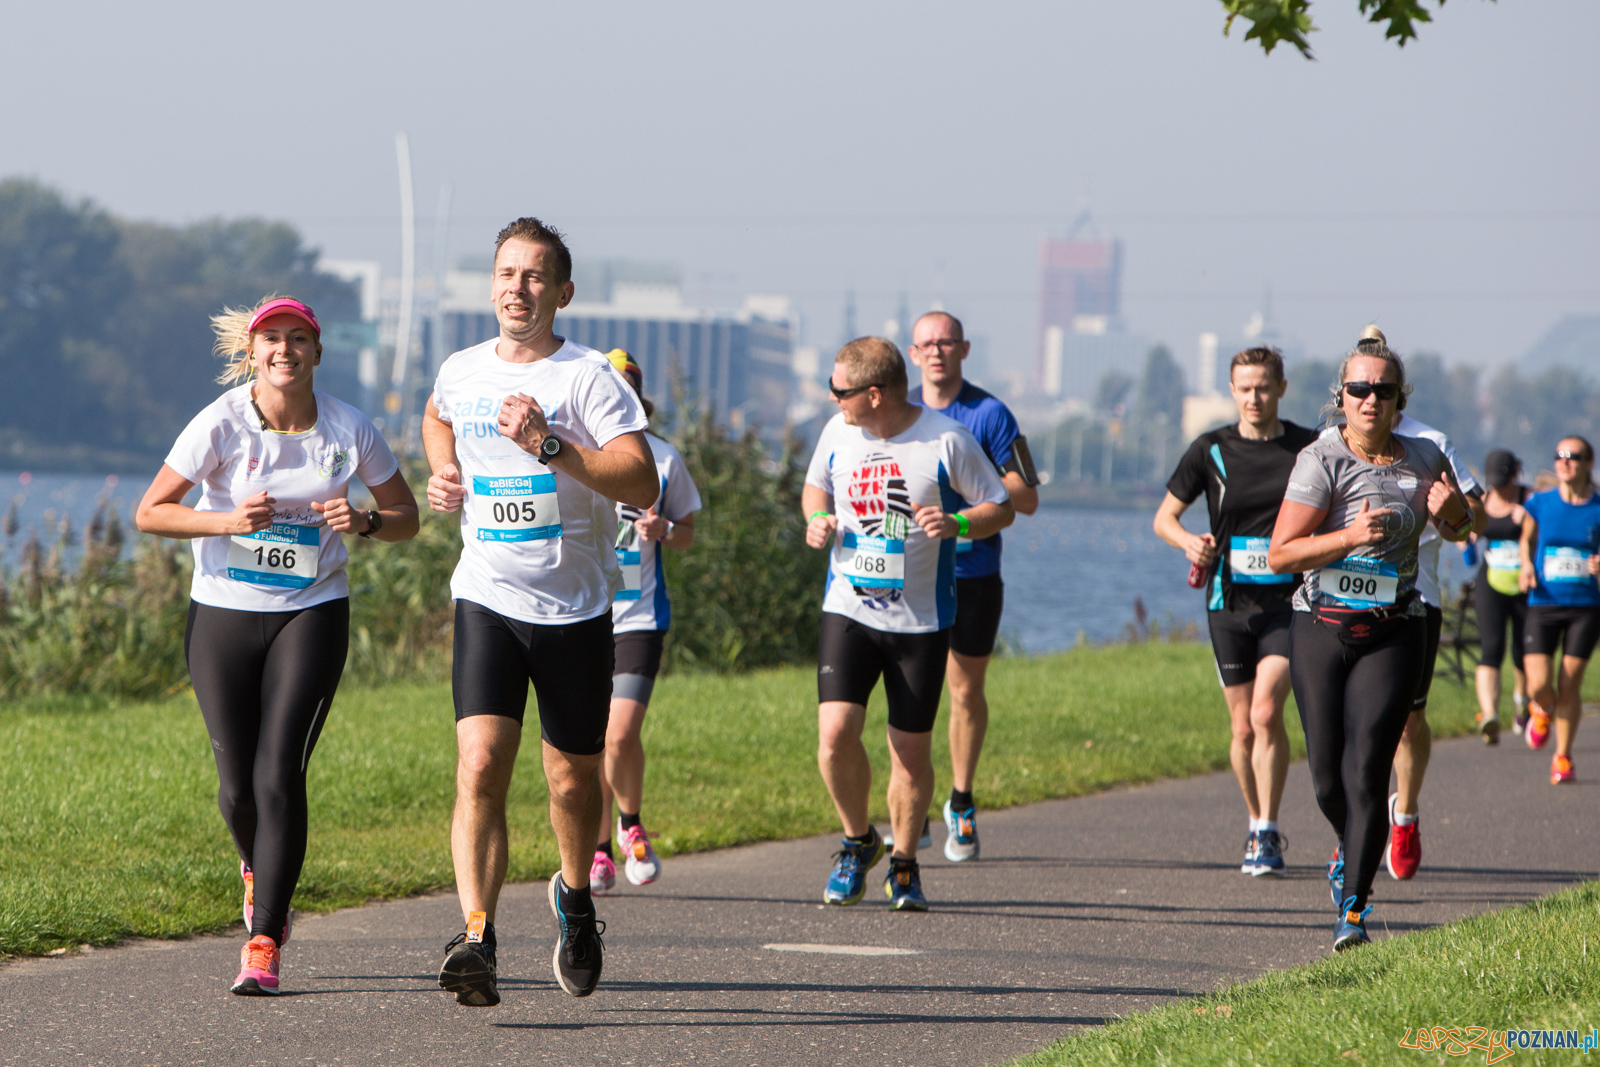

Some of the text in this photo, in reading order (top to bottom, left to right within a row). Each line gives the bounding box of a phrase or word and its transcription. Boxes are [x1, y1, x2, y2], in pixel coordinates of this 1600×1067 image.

[489, 478, 532, 489] zaBIEGaj
[495, 487, 533, 496] FUNdusze
[493, 501, 536, 524] 005
[260, 533, 299, 543] FUNdusze
[254, 546, 296, 570] 166
[855, 555, 885, 573] 068
[1247, 555, 1267, 569] 28
[1339, 575, 1377, 596] 090
